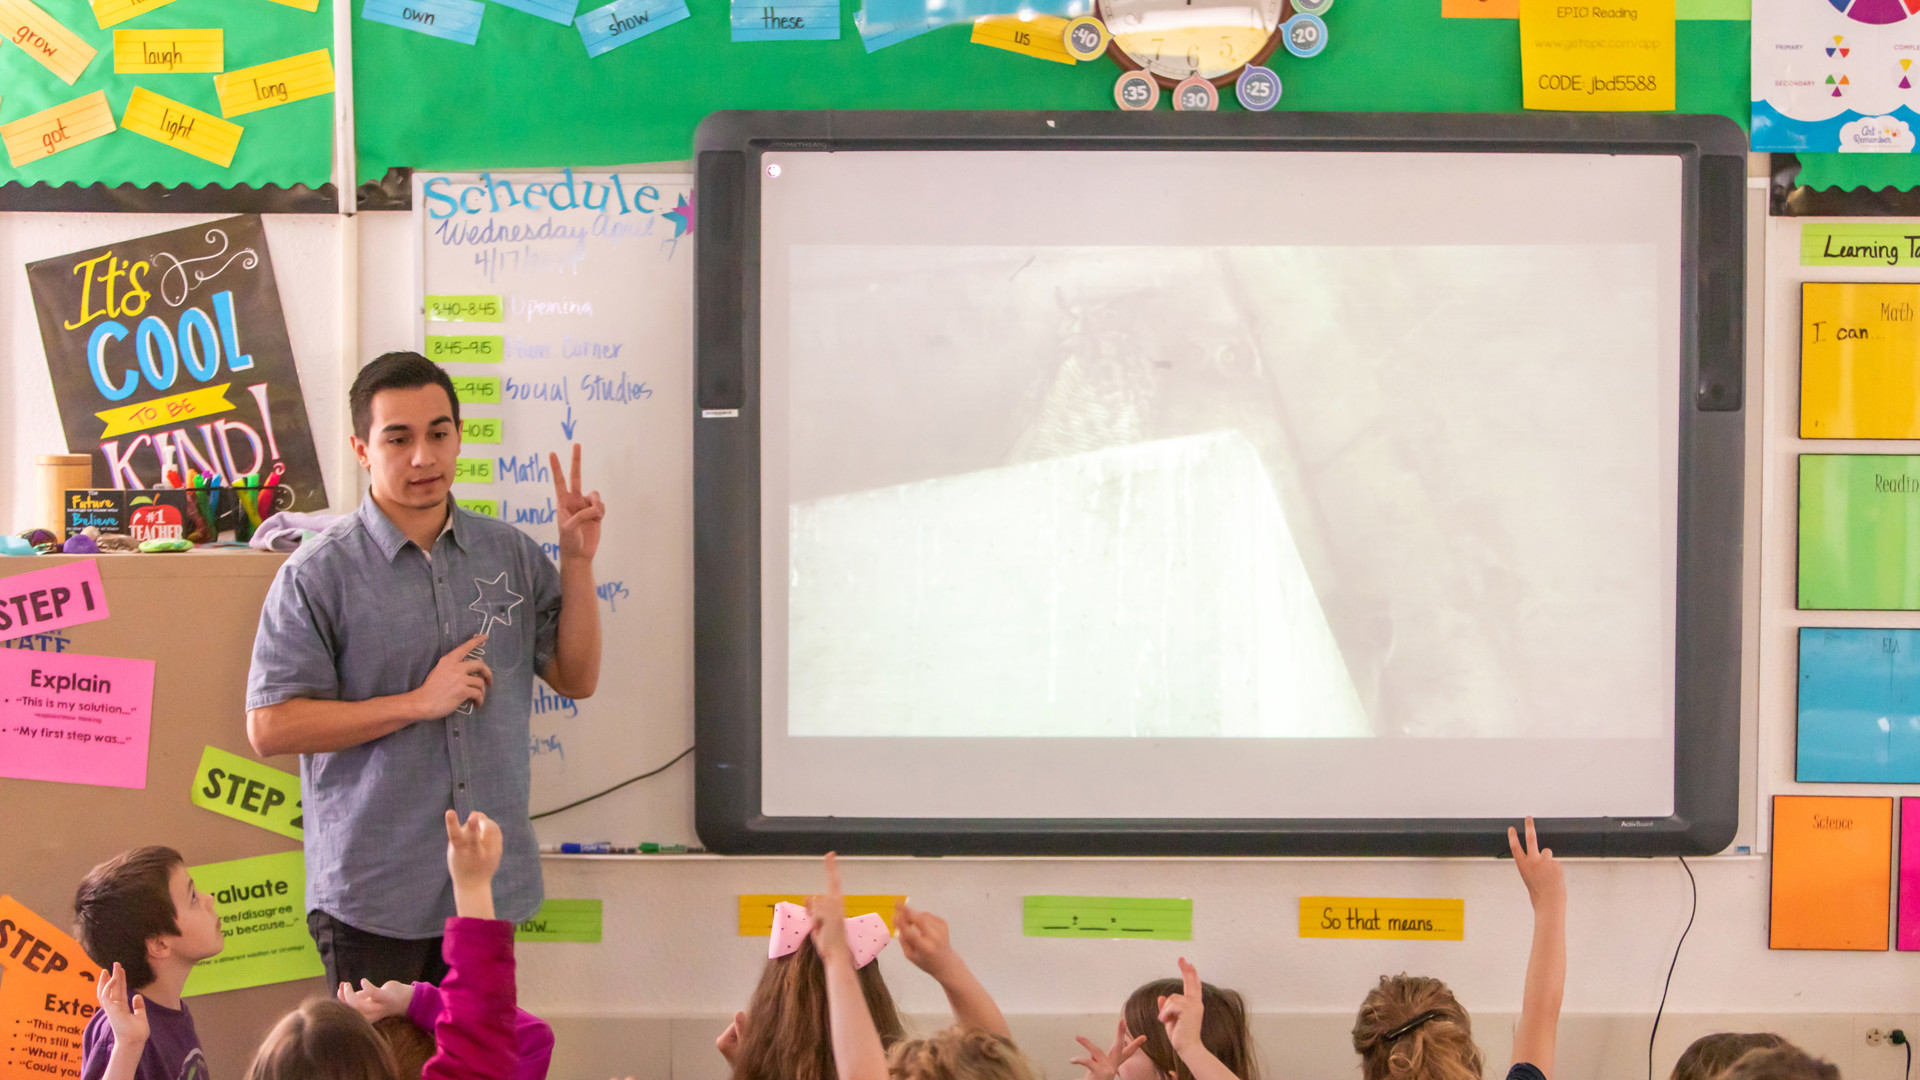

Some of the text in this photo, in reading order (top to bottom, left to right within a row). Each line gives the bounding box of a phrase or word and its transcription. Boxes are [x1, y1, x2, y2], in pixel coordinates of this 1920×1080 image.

[401, 6, 437, 26] own
[608, 10, 651, 38] show
[760, 9, 805, 30] these
[1592, 7, 1638, 21] Reading
[12, 25, 58, 58] grow
[1014, 30, 1031, 46] us
[1219, 35, 1234, 58] 5
[1291, 27, 1317, 43] :20
[143, 41, 183, 71] laugh
[1151, 38, 1165, 61] 7
[1186, 45, 1200, 69] 6
[252, 77, 288, 102] long
[1123, 85, 1148, 101] :35
[1246, 81, 1270, 97] :25
[1538, 74, 1657, 95] CODE: jbd5588
[1182, 92, 1208, 108] :30
[42, 117, 71, 154] got
[159, 107, 195, 142] light
[423, 167, 660, 220] Schedule
[435, 216, 587, 248] Wednesday
[1823, 235, 1899, 266] Learning
[63, 250, 152, 330] It's
[1880, 302, 1914, 322] Math
[1812, 321, 1828, 344] I
[86, 290, 255, 402] COOL
[562, 334, 624, 360] Corner
[505, 371, 653, 406] Social Studies
[128, 397, 196, 426] TO BE
[99, 383, 285, 490] KIND!
[498, 452, 549, 484] Math
[72, 495, 115, 510] Future
[71, 512, 119, 527] Believe
[145, 509, 166, 524] #1
[128, 524, 184, 541] TEACHER
[0, 587, 71, 631] STEP
[1882, 637, 1901, 653] ELA
[30, 669, 111, 694] Explain
[46, 698, 54, 708] is
[57, 700, 76, 712] my
[40, 728, 64, 739] first
[67, 731, 92, 743] step
[202, 767, 286, 817] STEP
[1812, 814, 1854, 831] Science
[210, 880, 289, 905] aluate
[1320, 907, 1342, 930] So
[1345, 907, 1382, 931] that
[0, 918, 69, 974] STEP
[50, 1035, 69, 1048] still
[60, 1066, 82, 1078] you
